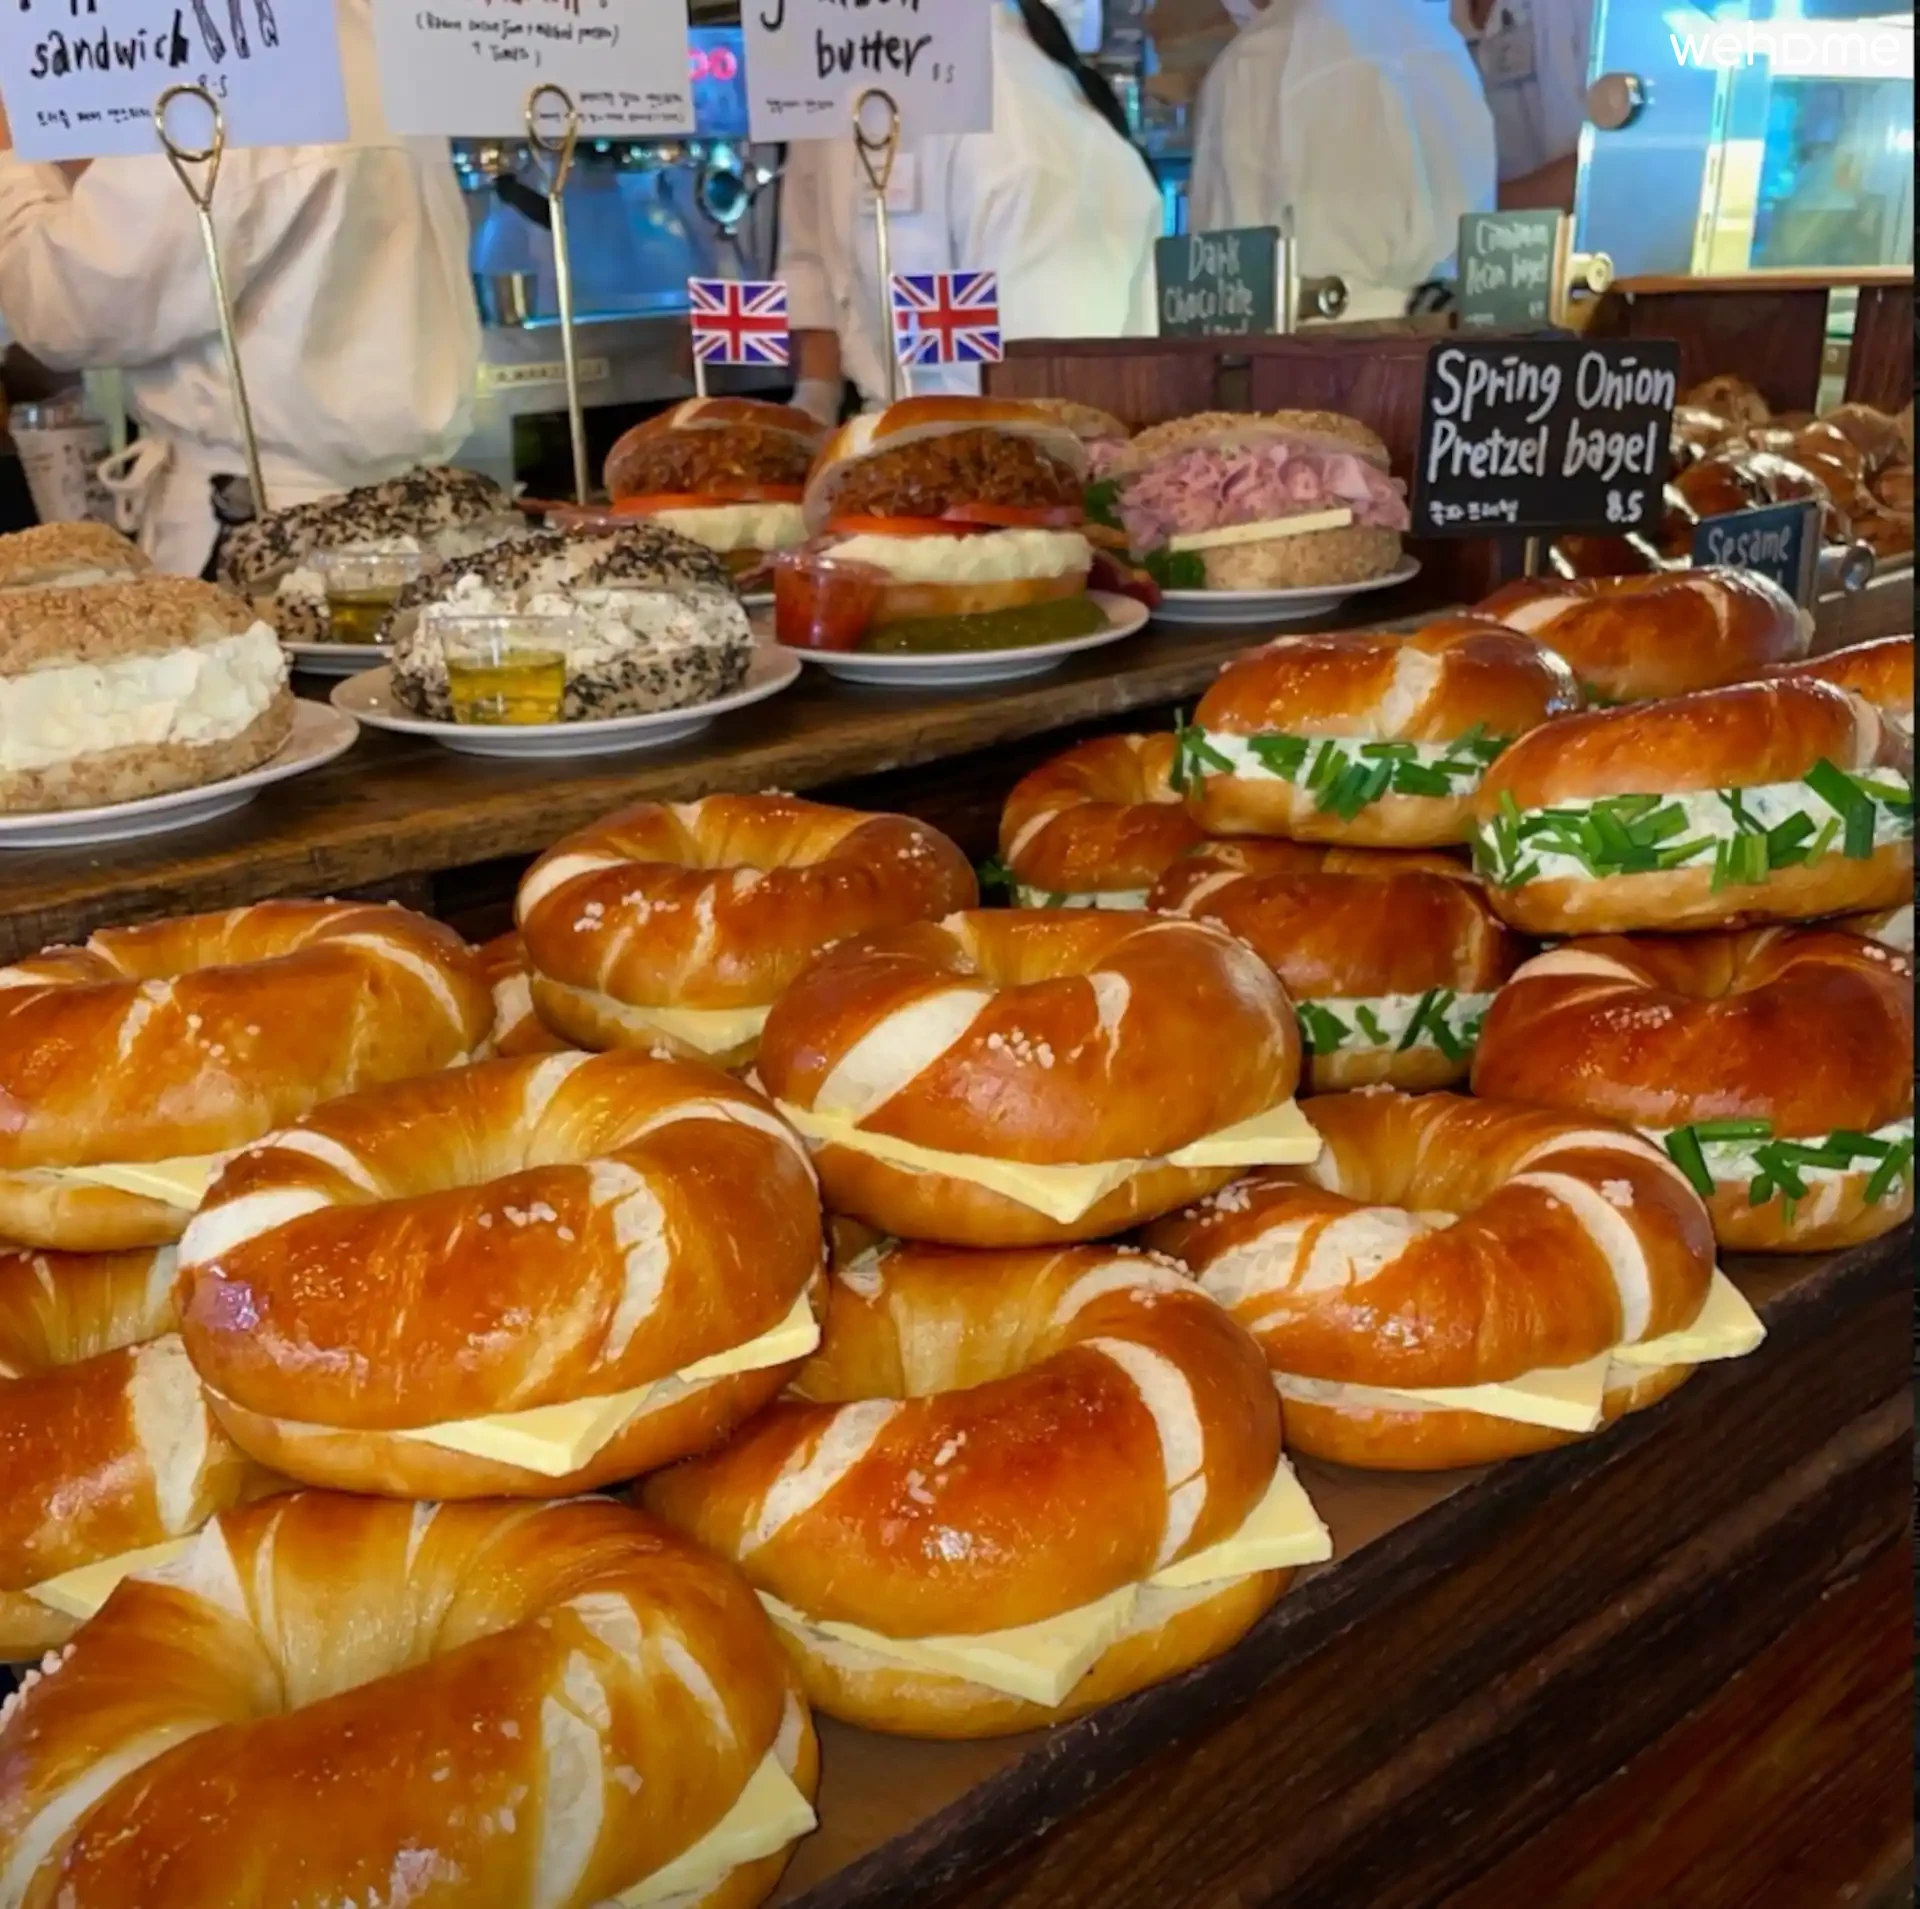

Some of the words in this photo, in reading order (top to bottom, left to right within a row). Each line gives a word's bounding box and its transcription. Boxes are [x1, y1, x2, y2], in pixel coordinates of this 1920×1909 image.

[816, 28, 932, 79] butter
[1188, 234, 1241, 282] Dark
[1431, 349, 1562, 424] Spring
[1576, 350, 1676, 412] Onion
[1427, 418, 1549, 484] Pretzel
[1562, 416, 1658, 483] bagel
[1606, 489, 1645, 523] 8.5
[1708, 526, 1792, 571] Sesame
